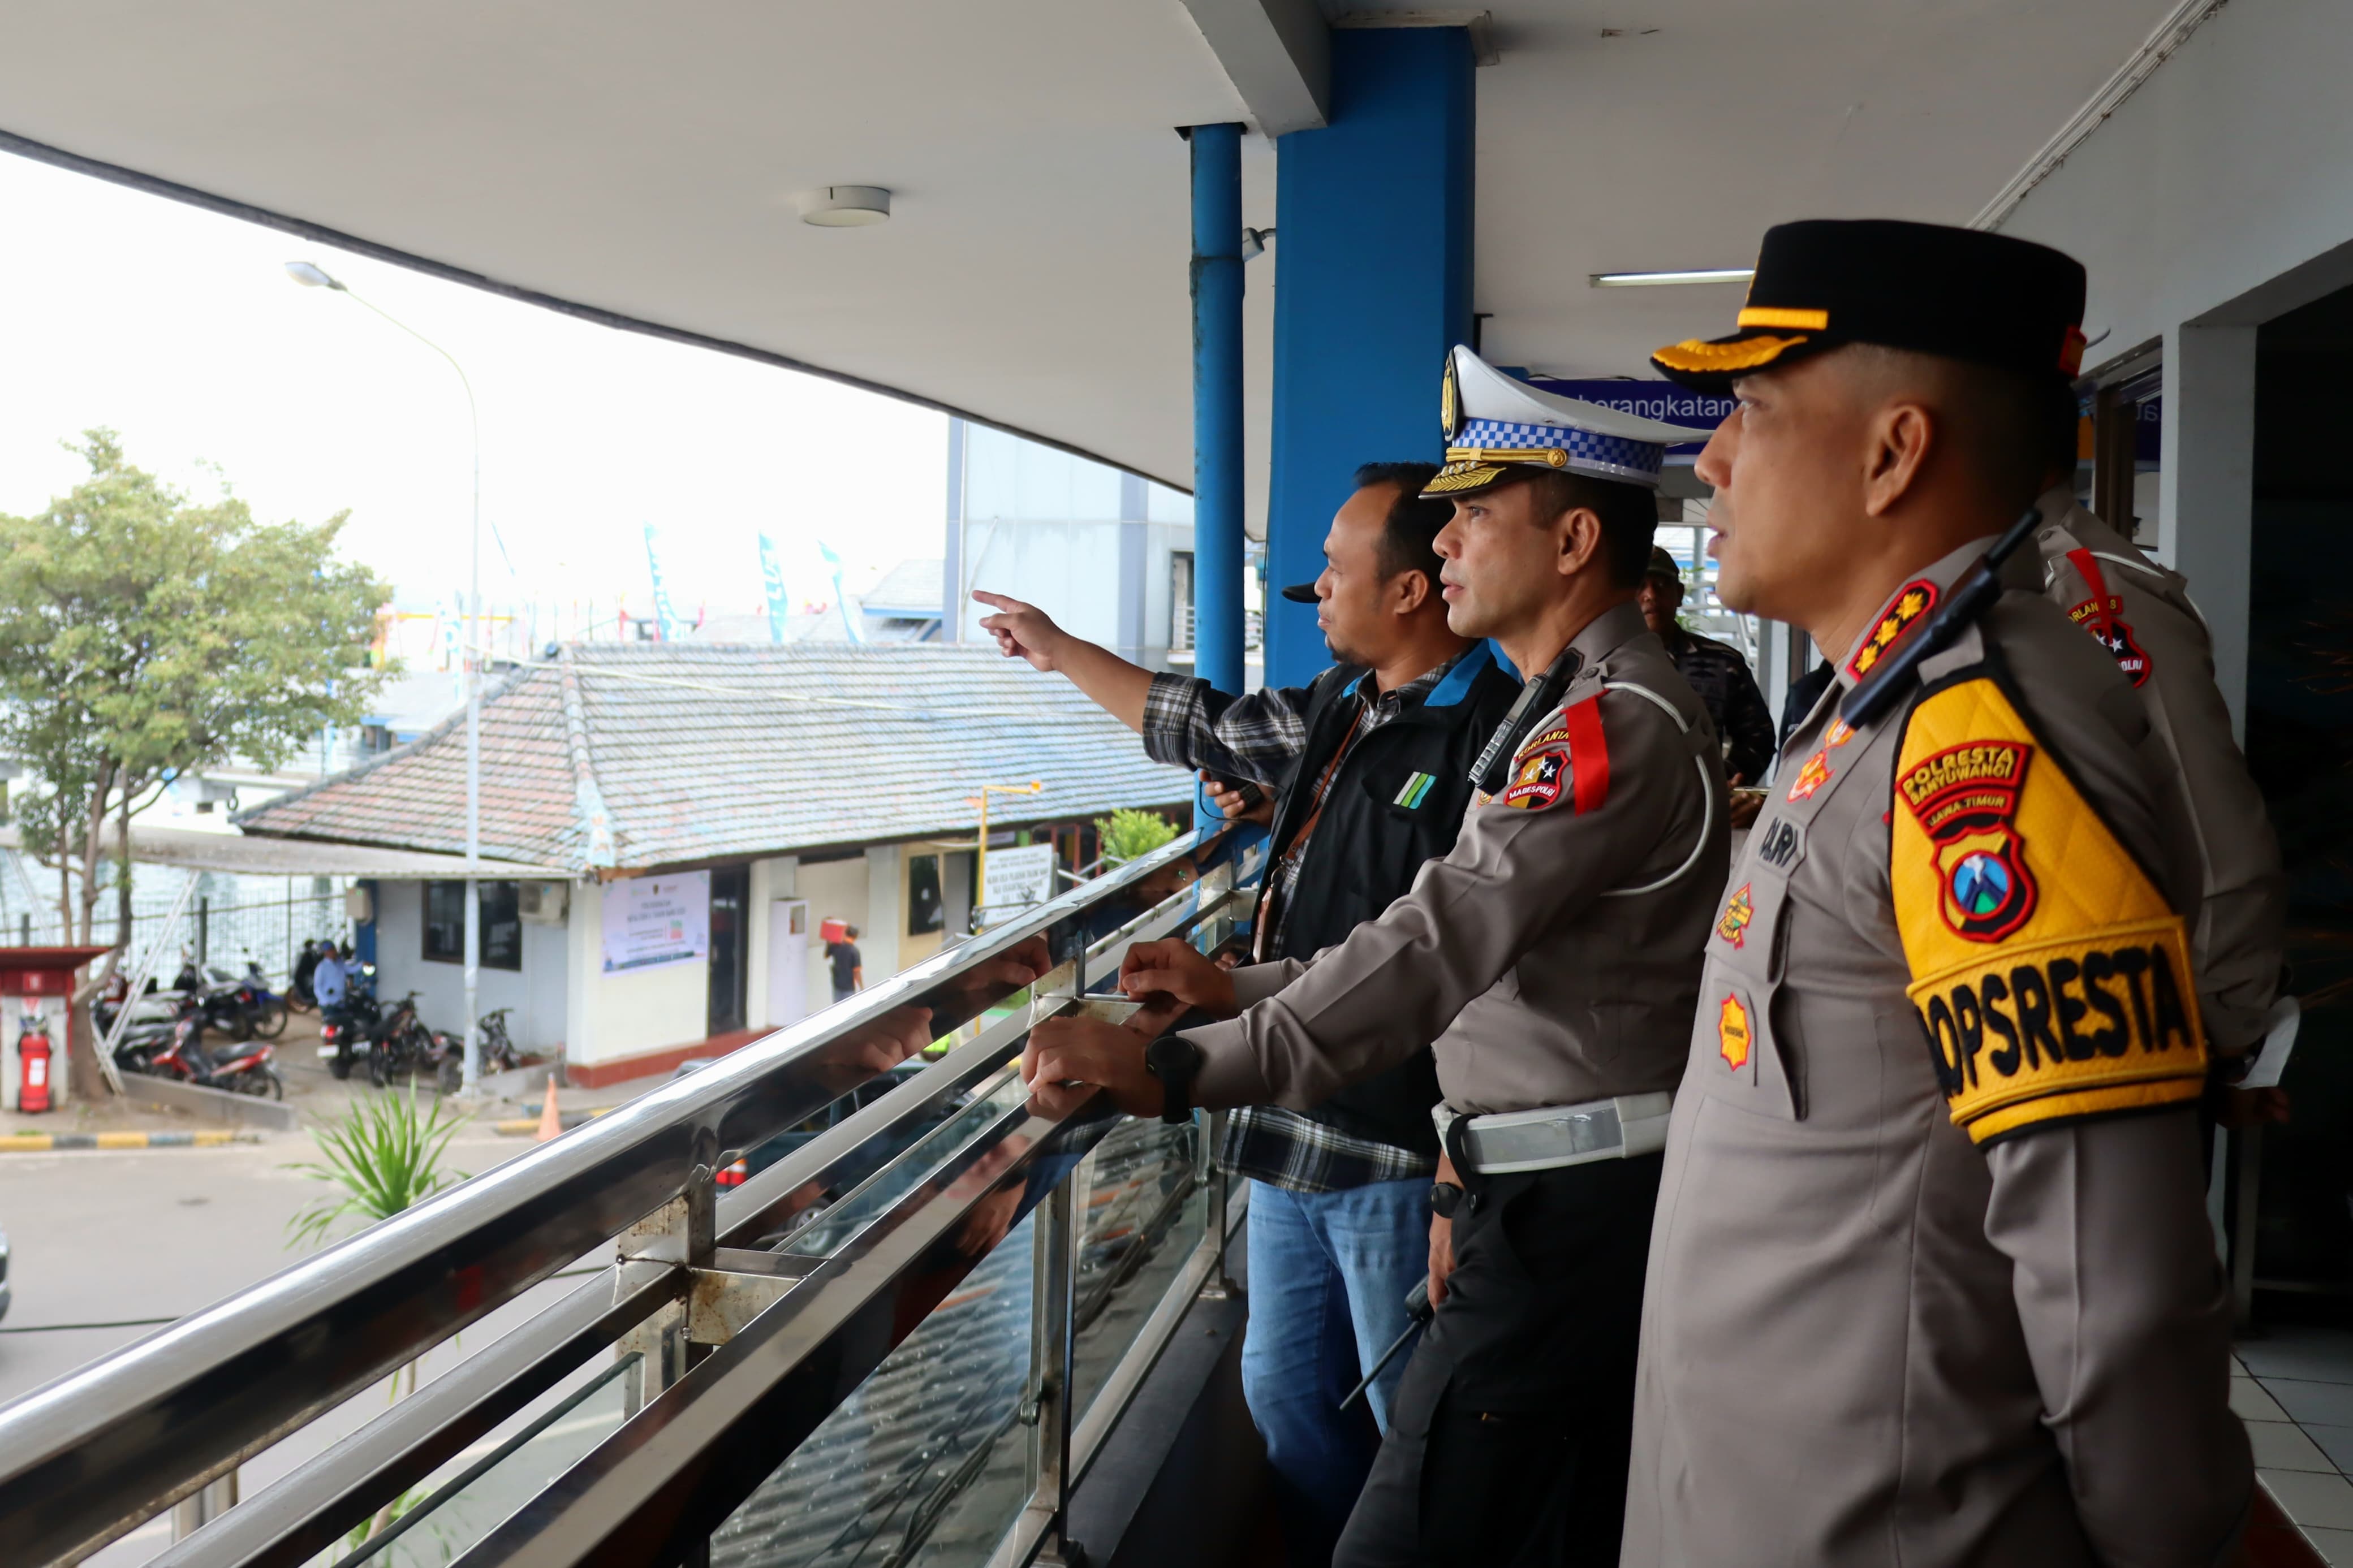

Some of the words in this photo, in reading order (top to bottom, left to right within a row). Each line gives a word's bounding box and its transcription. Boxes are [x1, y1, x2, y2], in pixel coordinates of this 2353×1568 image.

[1518, 730, 1569, 759] KORLANTA
[1902, 747, 2015, 796] POLRESTA
[1928, 801, 1962, 826] JAWA
[1964, 794, 2006, 808] TIMUR
